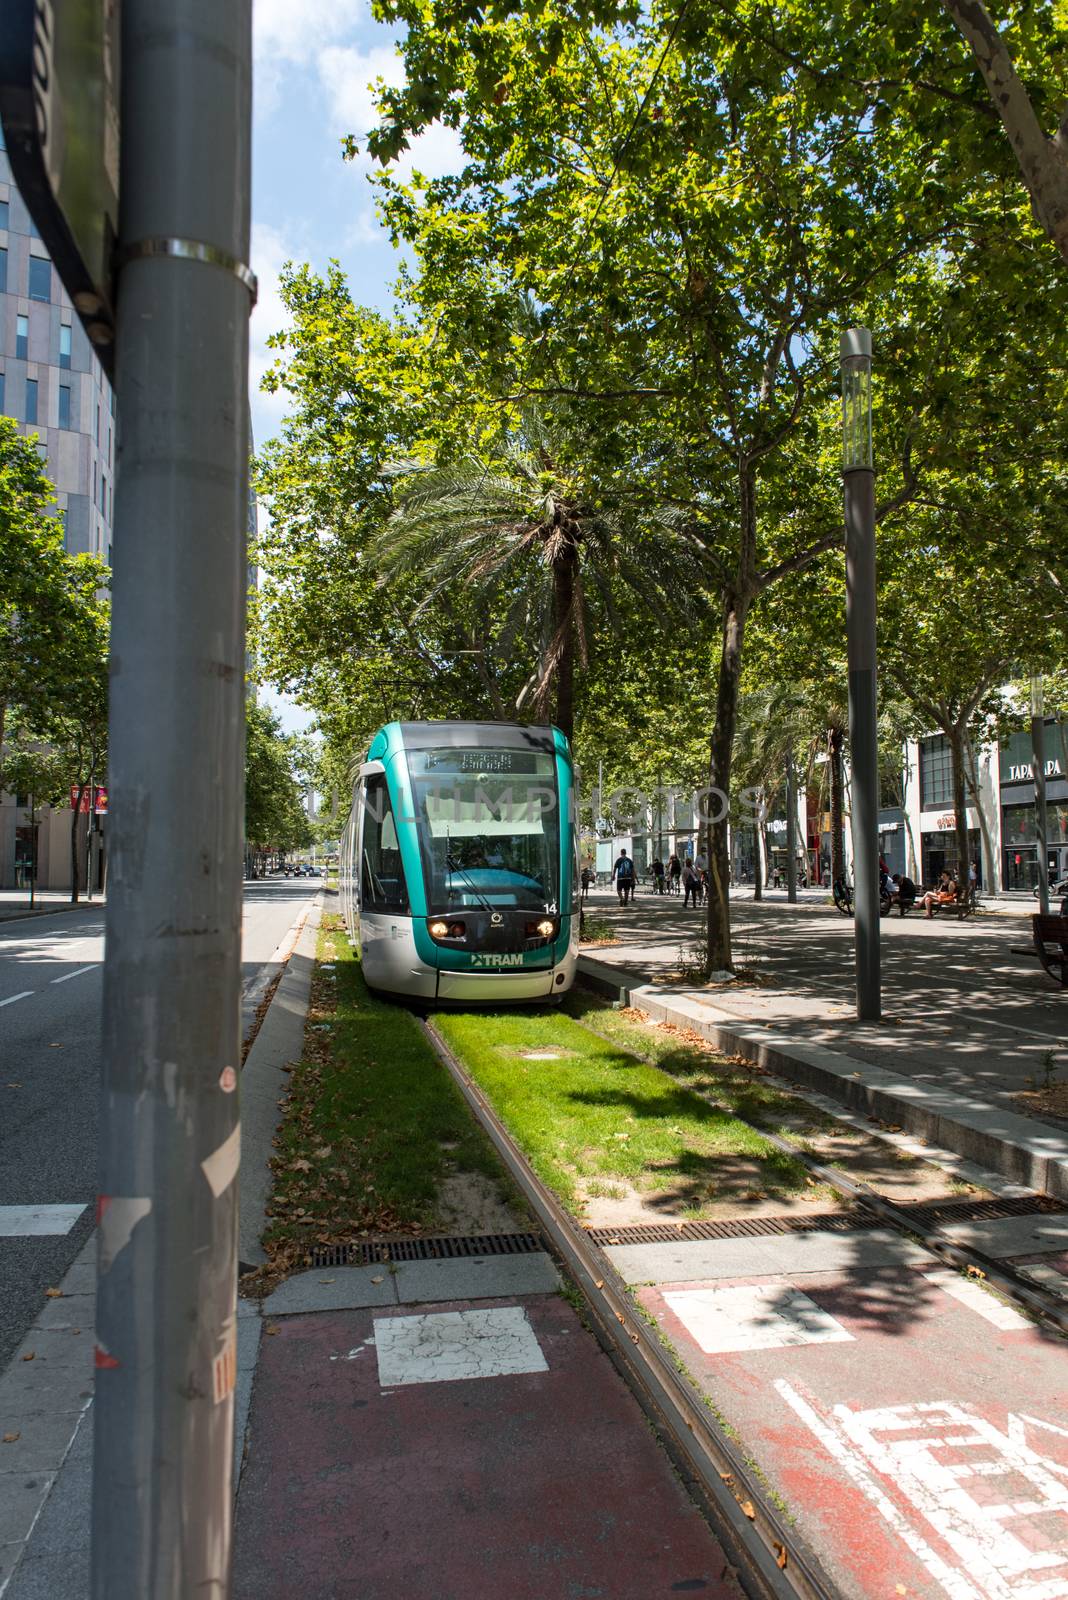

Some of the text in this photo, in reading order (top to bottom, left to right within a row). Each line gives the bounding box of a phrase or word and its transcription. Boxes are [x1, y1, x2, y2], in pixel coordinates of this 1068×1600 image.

[1009, 764, 1034, 781] TAPA
[543, 903, 558, 915] 14
[483, 954, 524, 966] TRAM
